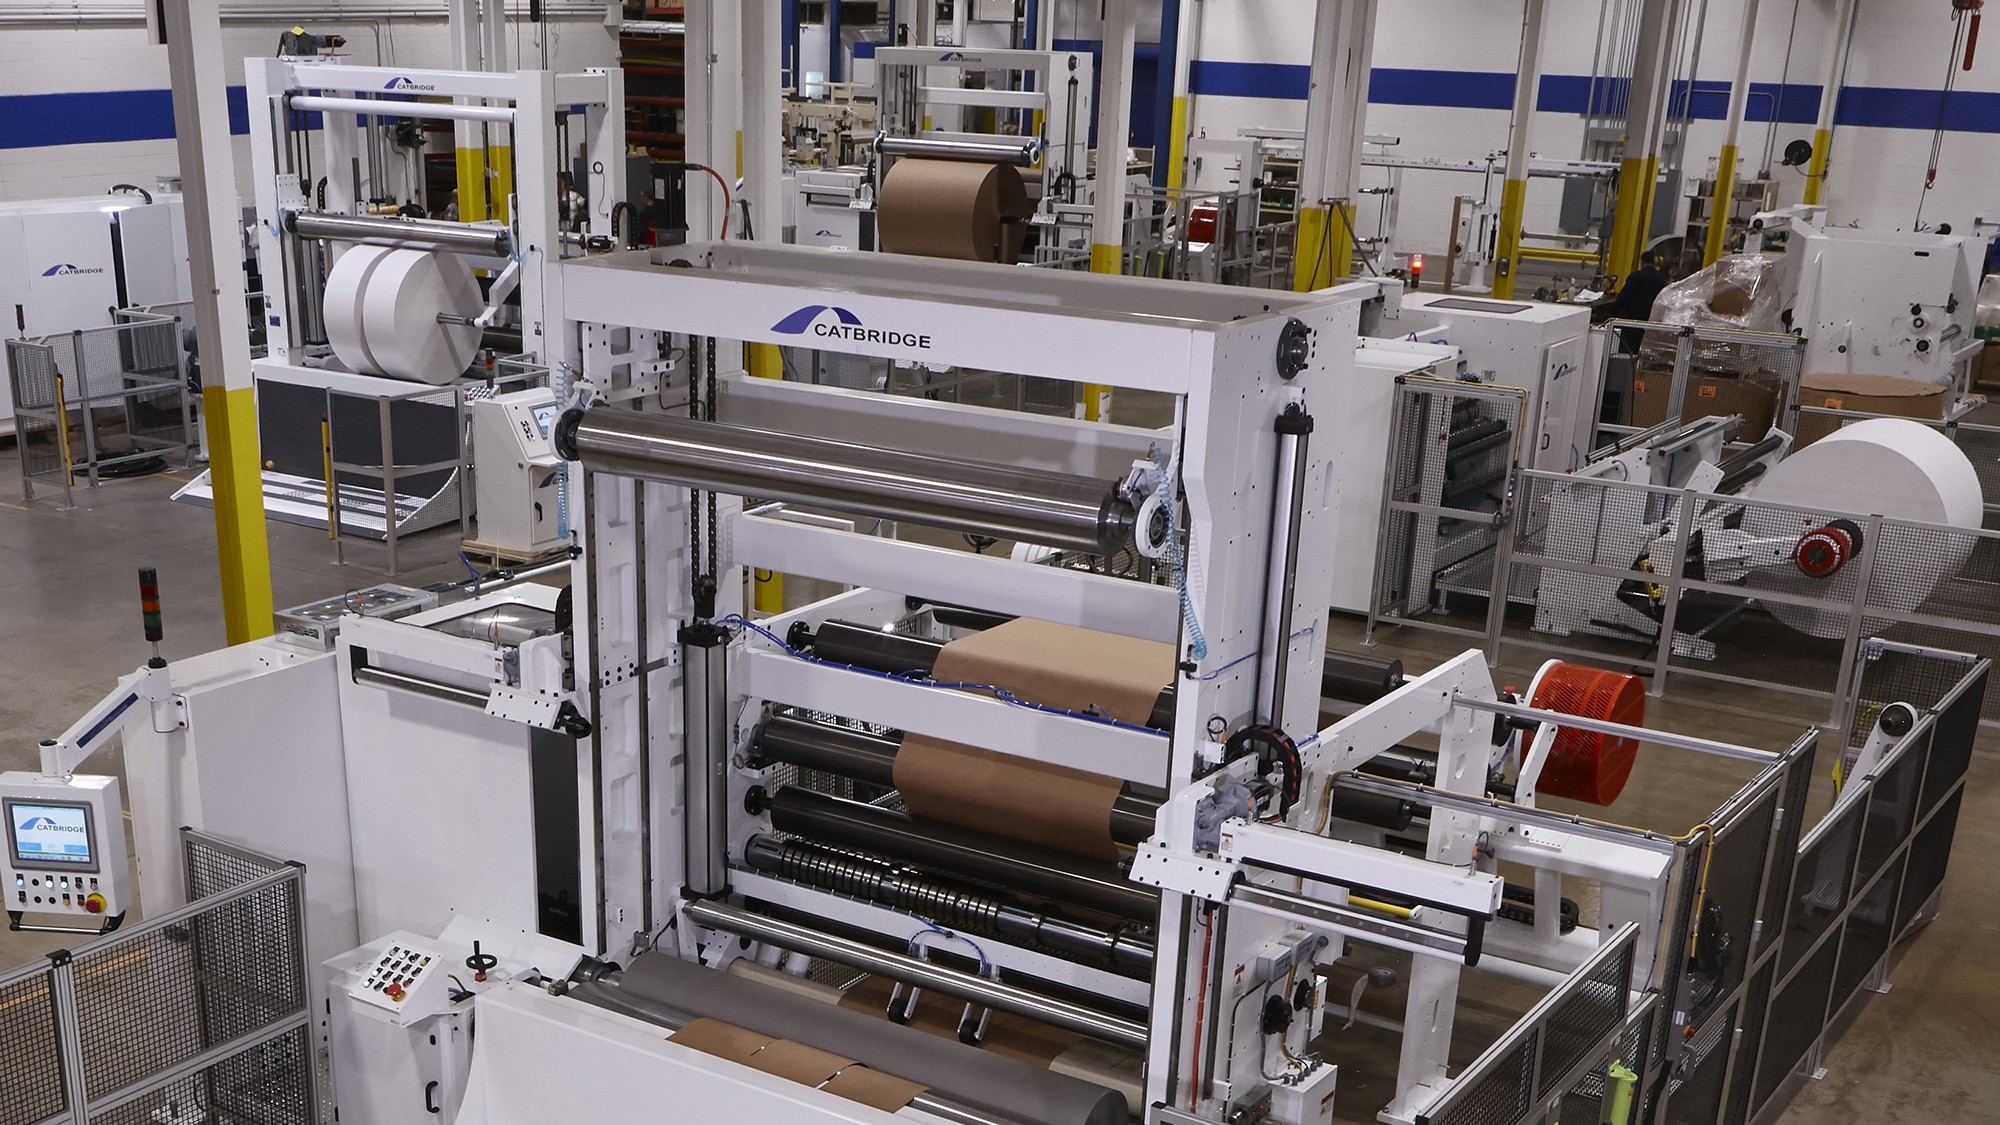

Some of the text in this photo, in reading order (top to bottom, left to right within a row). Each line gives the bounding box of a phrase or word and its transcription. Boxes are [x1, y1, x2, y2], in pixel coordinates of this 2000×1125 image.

[58, 267, 104, 276] CATBRIDGE
[814, 323, 931, 349] CATBRIDGE
[36, 824, 85, 833] CATBRIDGE
